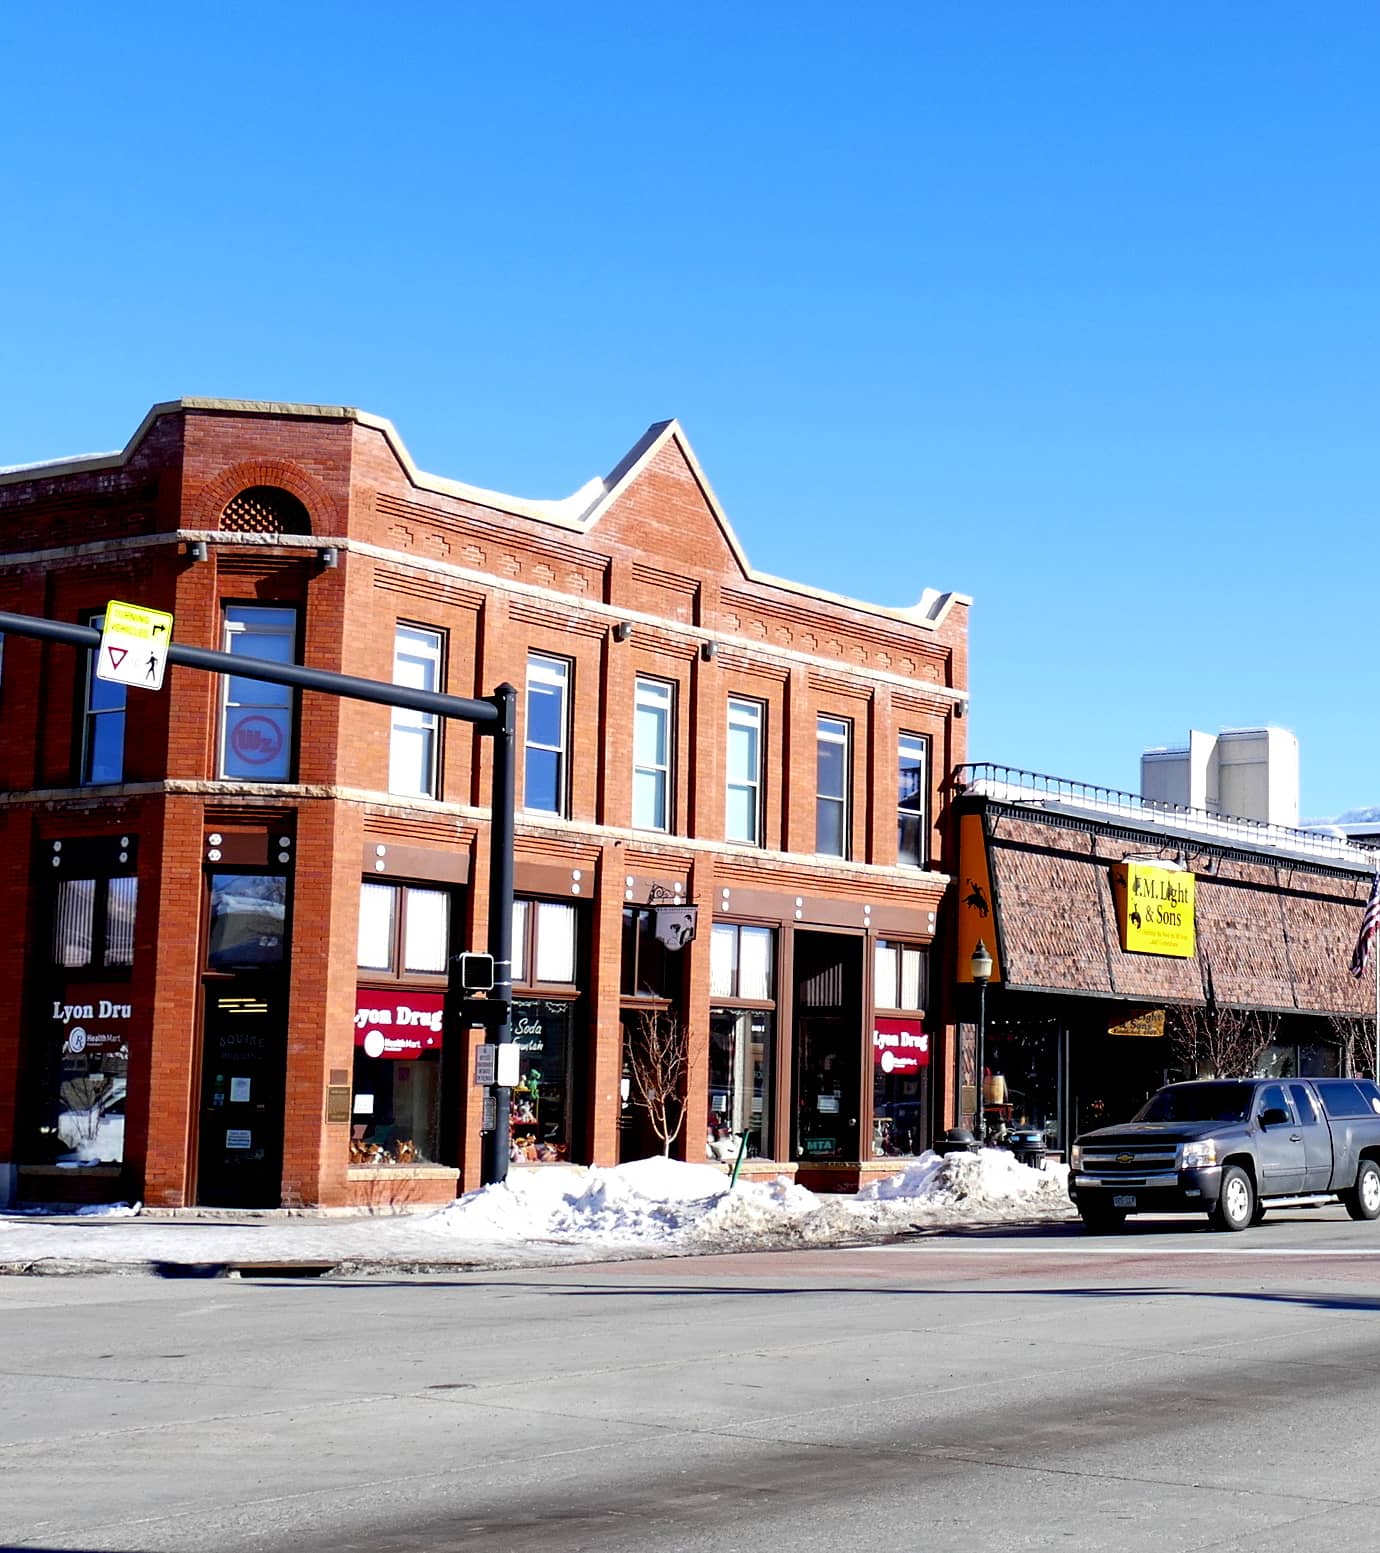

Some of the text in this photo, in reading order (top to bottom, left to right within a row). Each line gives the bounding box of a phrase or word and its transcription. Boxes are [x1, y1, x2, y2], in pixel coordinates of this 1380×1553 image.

[1161, 880, 1189, 908] Light
[1145, 904, 1182, 927] & Sons
[53, 1000, 132, 1024] Lyon Dru
[354, 1006, 443, 1032] yon Drug
[515, 1018, 543, 1035] Soda
[873, 1030, 928, 1051] Lyon Drug
[807, 1141, 832, 1150] MTA
